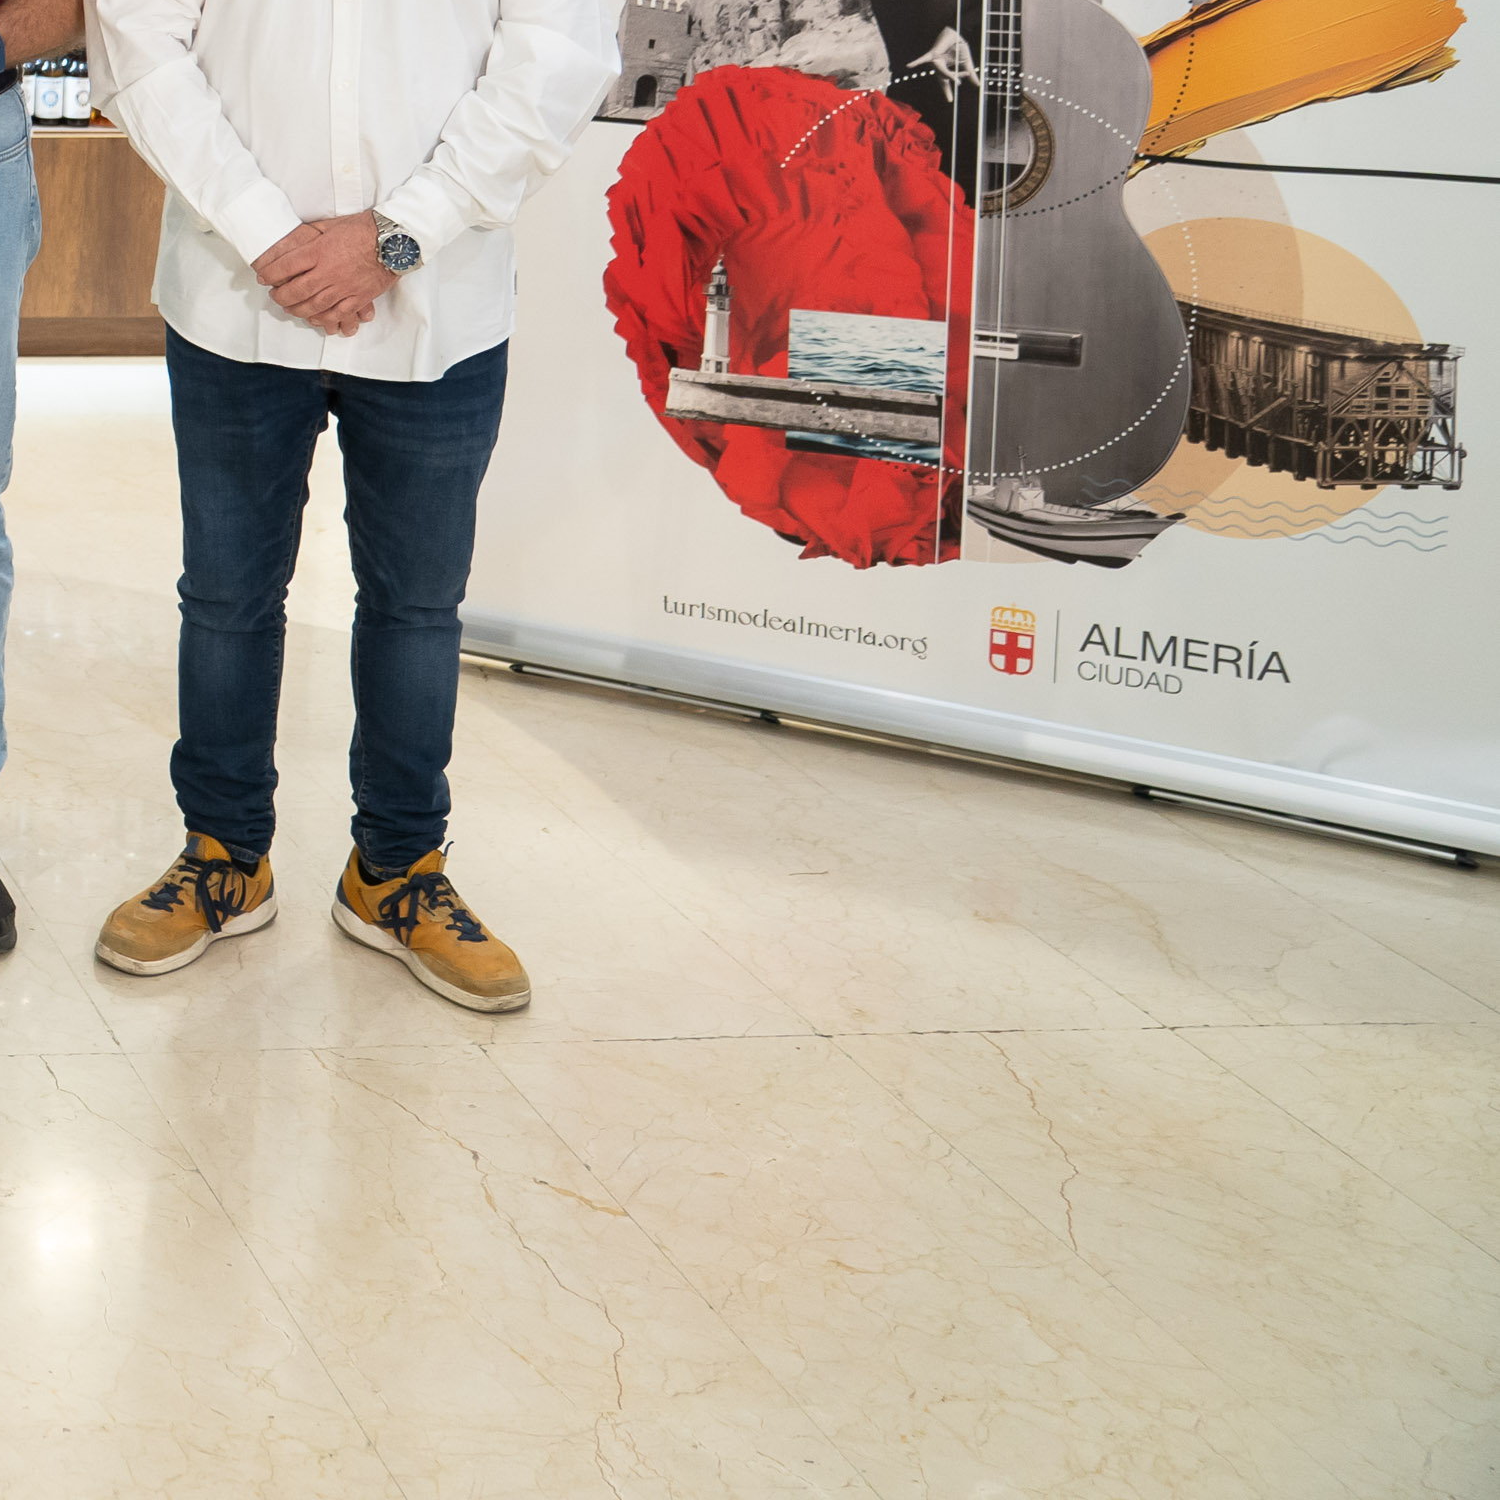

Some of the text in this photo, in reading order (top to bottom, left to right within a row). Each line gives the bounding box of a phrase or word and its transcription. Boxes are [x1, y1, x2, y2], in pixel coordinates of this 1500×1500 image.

[662, 594, 929, 660] turismodealmeria.org
[1078, 623, 1291, 683] ALMERÍA
[1077, 660, 1183, 695] CIUDAD
